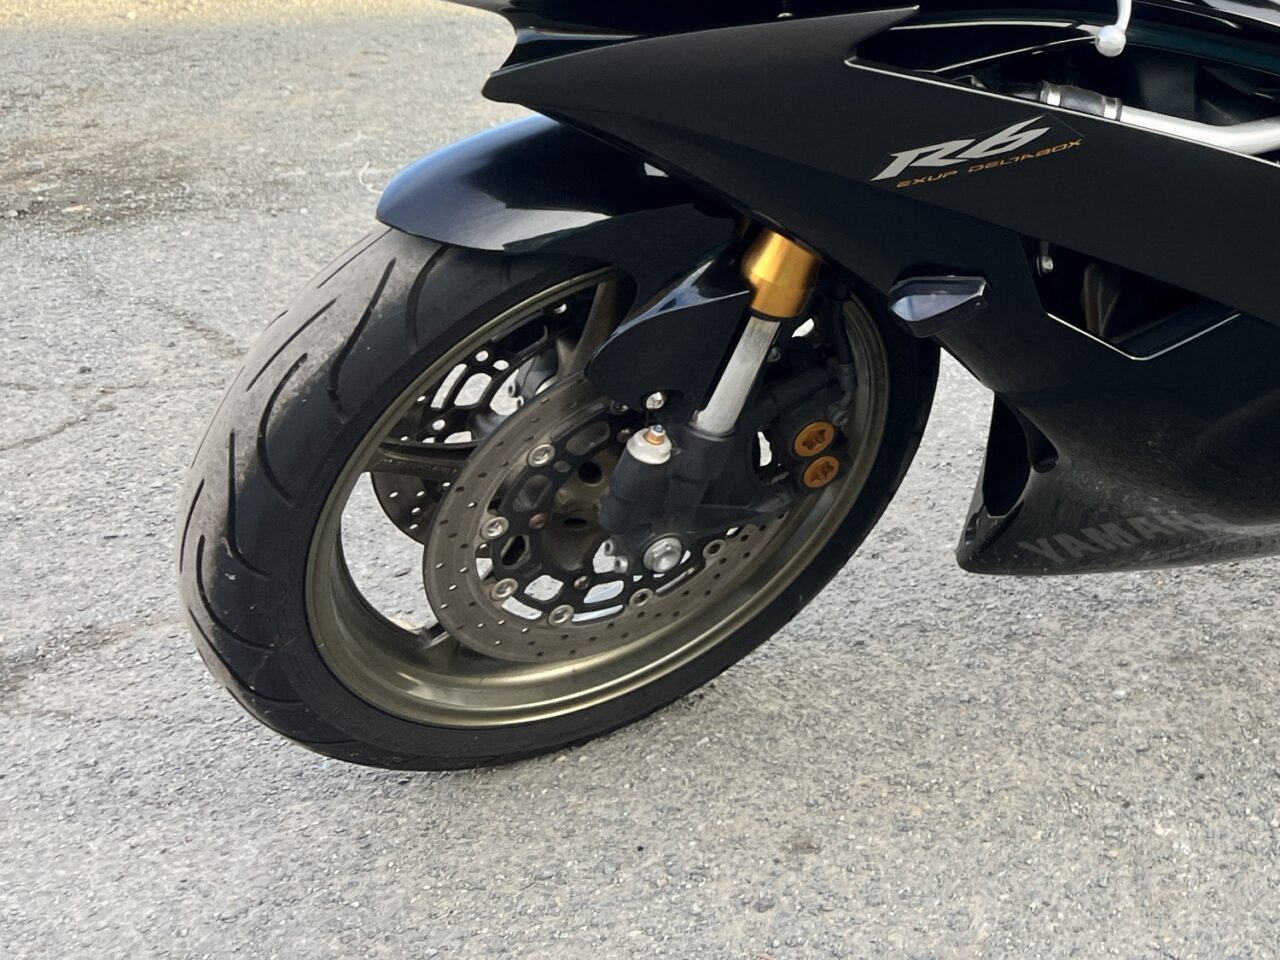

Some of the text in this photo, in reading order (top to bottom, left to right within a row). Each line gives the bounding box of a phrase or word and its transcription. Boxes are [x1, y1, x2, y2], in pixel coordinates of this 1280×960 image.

[870, 115, 1051, 181] R6
[897, 139, 1082, 188] EXUP DELTABOX
